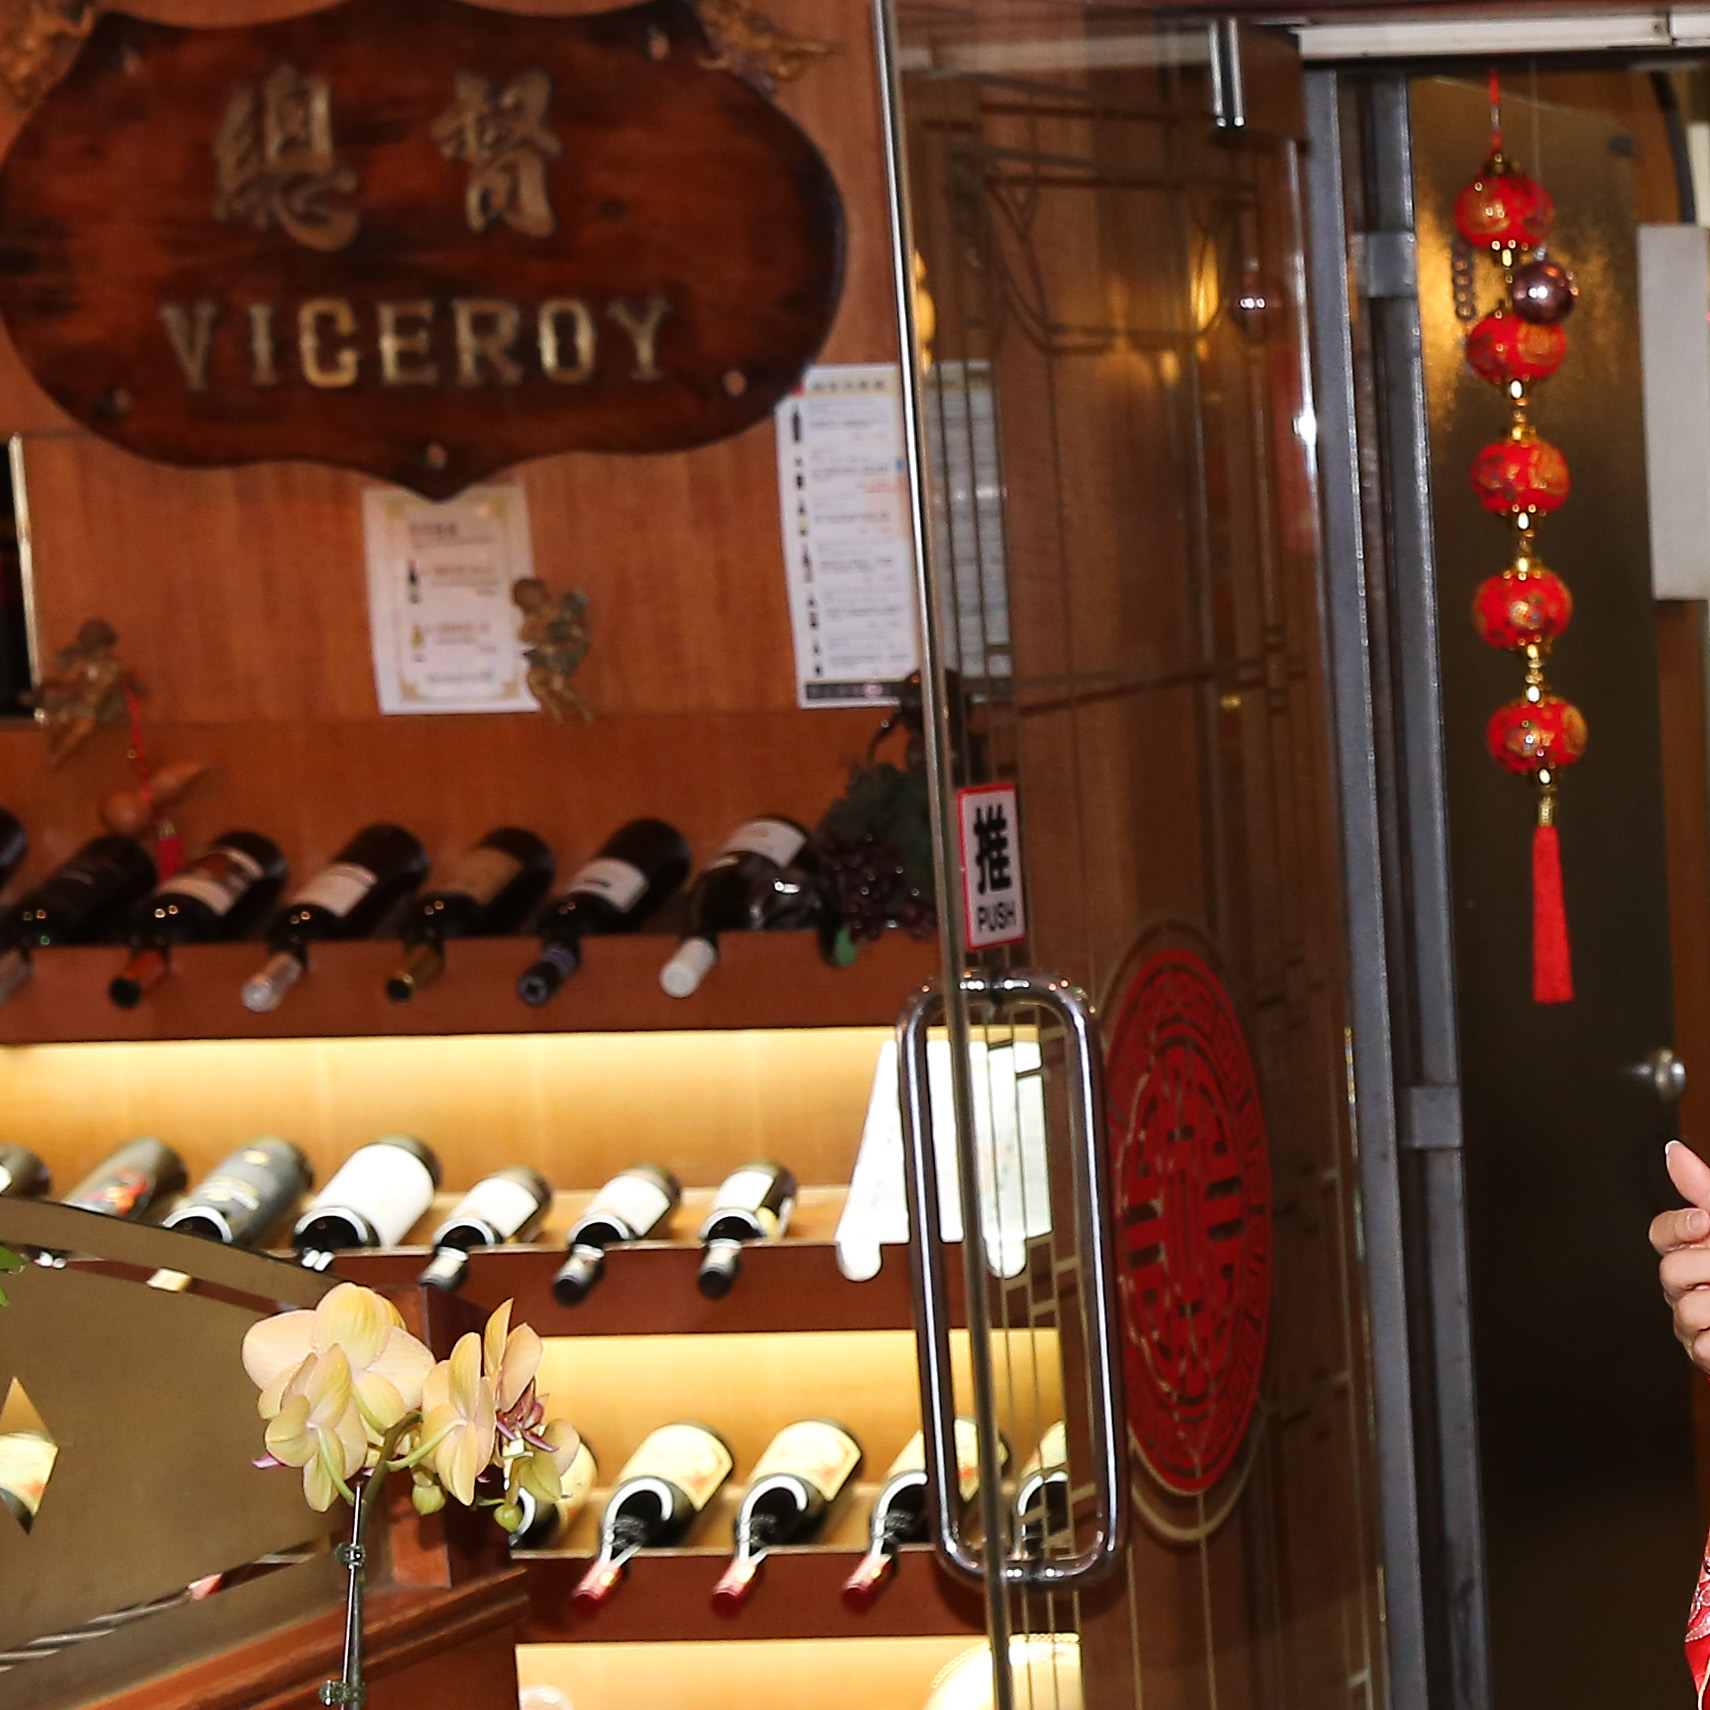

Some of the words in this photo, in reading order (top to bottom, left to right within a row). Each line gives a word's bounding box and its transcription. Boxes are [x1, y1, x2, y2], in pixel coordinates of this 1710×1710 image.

[211, 62, 567, 253] 總督
[158, 297, 675, 393] VICEROY
[973, 804, 1014, 895] 推
[977, 901, 1018, 933] PUSH
